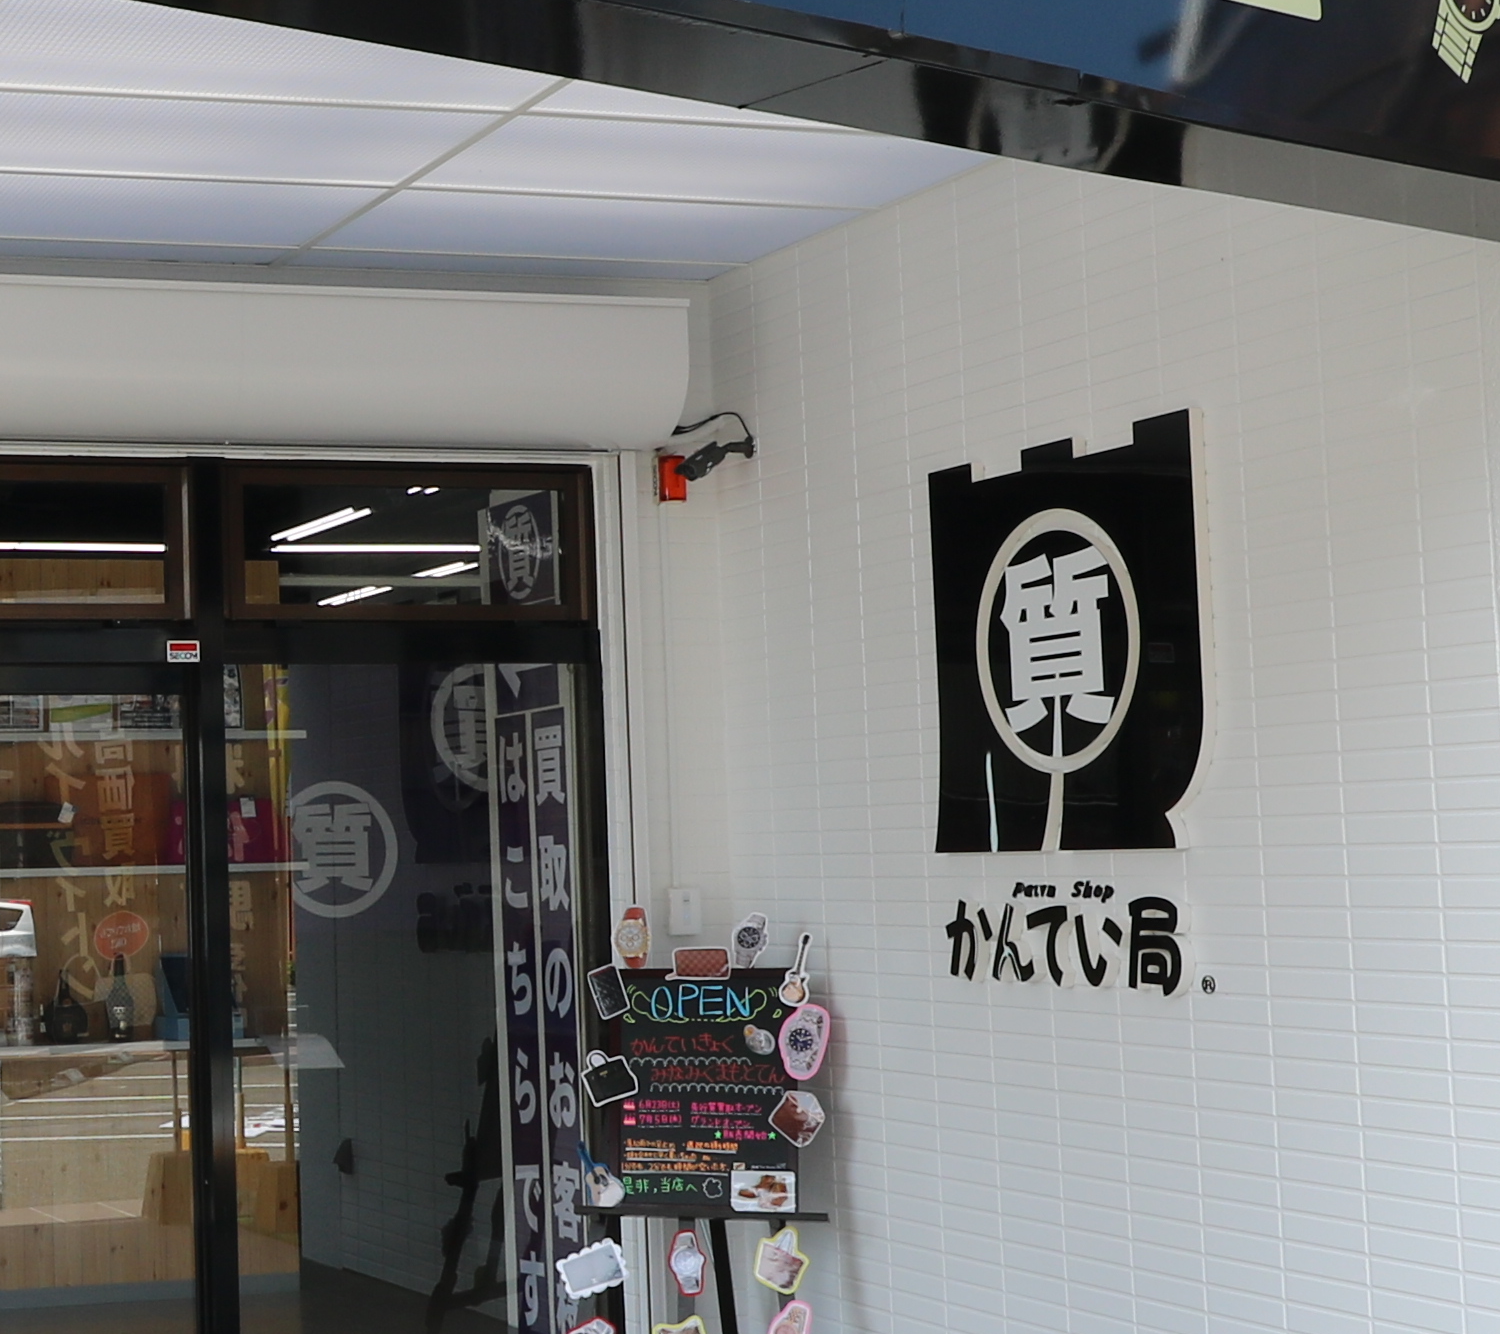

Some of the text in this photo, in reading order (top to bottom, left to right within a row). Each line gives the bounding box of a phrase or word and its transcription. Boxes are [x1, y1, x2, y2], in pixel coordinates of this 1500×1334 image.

[1000, 545, 1115, 733] 質
[1071, 880, 1115, 903] Shop
[945, 896, 1184, 997] かんてい局
[650, 983, 751, 1020] OPEN
[498, 732, 546, 1327] はこちらです
[630, 1032, 735, 1056] かんていきょく
[650, 1062, 786, 1084] みなみくまもとてん
